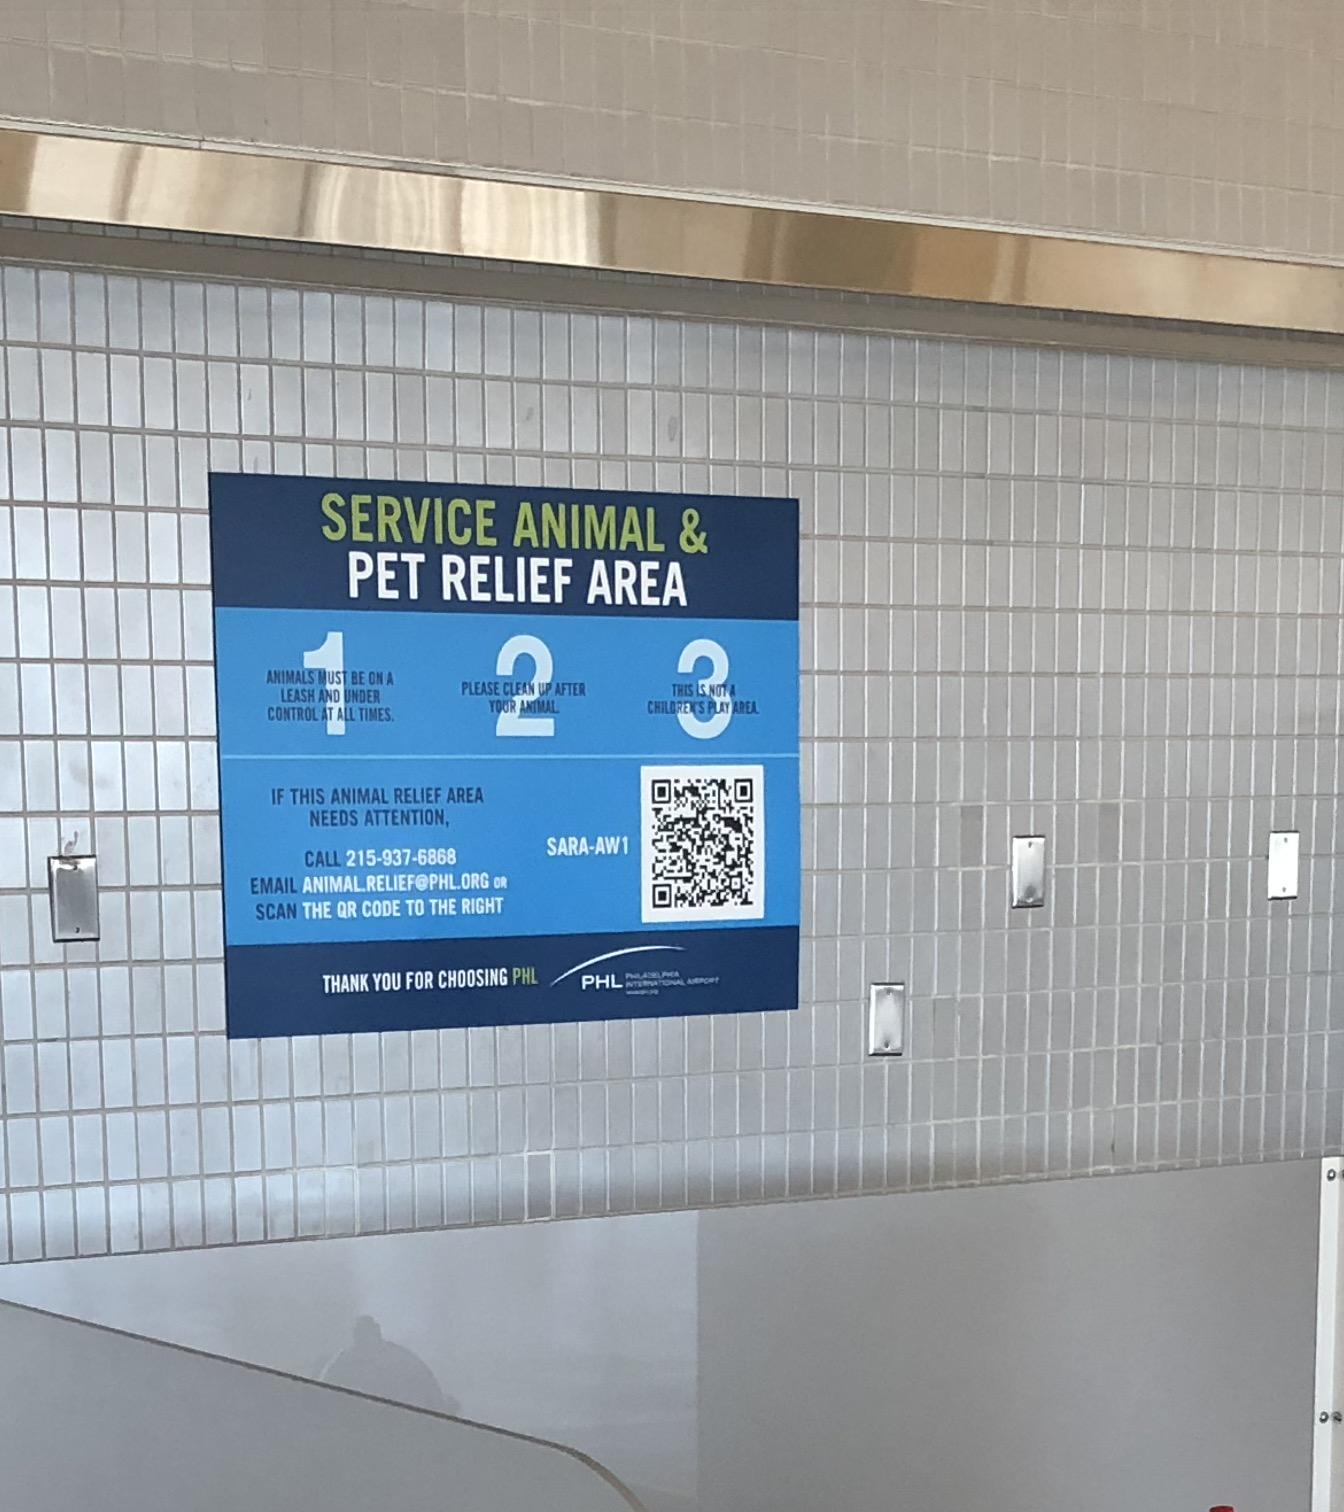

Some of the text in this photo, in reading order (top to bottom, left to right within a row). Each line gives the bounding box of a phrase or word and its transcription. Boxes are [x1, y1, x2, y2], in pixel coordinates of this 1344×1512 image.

[320, 491, 710, 555] SERVICE ANIMAL &
[347, 550, 689, 608] PET RELIEF AREA
[266, 669, 394, 685] ANIMALS MUST BE ON A
[303, 631, 346, 736] 1
[495, 634, 555, 737] 2
[280, 688, 381, 704] LEASH AND UNDER
[461, 681, 586, 697] PLEASE CLEAN UP AFTER
[672, 683, 736, 698] THIS IS NOT A
[677, 638, 733, 740] 3
[267, 706, 395, 722] CONTROL AT ALL TIMES.
[488, 699, 560, 714] YOUR ANIMAL.
[647, 700, 760, 715] CHILDREN'S PLAY AREA.
[272, 786, 484, 806] IF THIS ANIMAL RELIEF AREA
[309, 808, 450, 828] NEEDS ATTENTION,
[546, 835, 629, 856] SARA-AW1
[305, 848, 457, 868] CALL 215-937-6868
[250, 872, 508, 895] EMAIL ANIMAL.RELIEF@PHL.ORG OR
[256, 896, 504, 921] SCAN THE QR CODE TO THE RIGHT
[322, 966, 538, 994] THANK YOU FOR CHOOSING PHL
[581, 974, 623, 990] PHL
